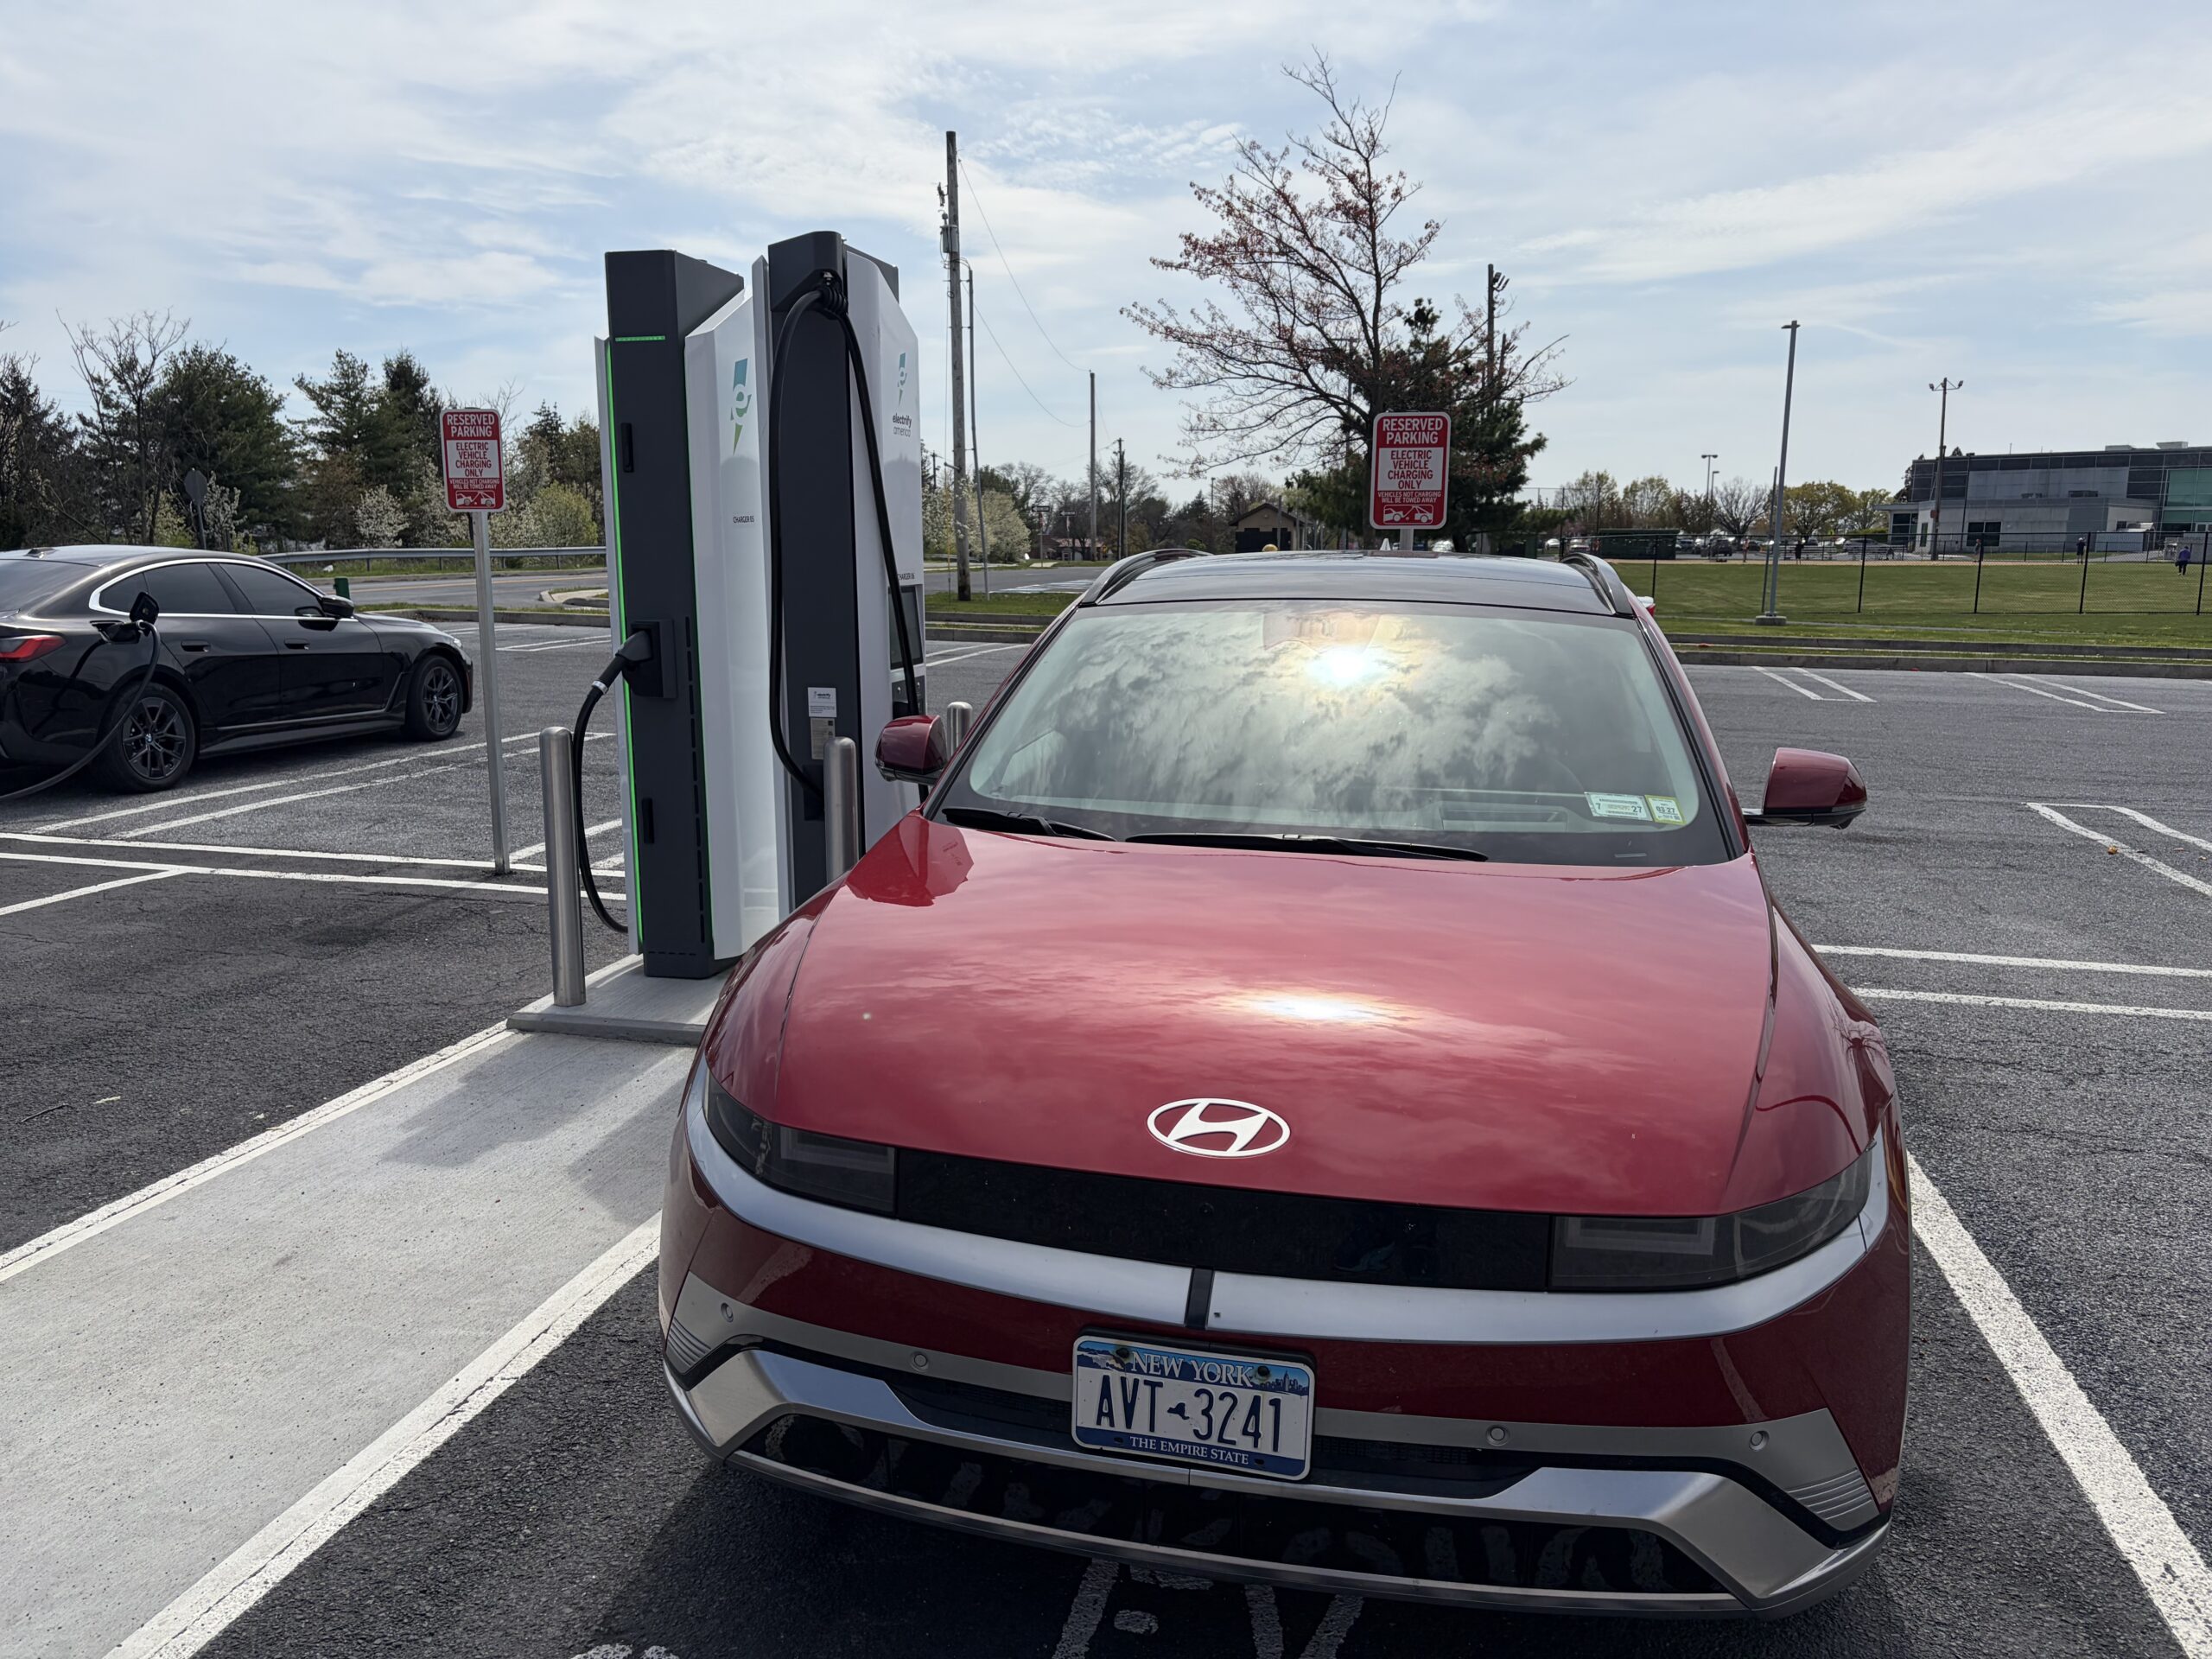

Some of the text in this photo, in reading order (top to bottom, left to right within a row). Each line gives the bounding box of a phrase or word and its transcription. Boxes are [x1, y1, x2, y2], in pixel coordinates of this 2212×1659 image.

[447, 414, 495, 426] RESERVED
[893, 412, 912, 428] electrify
[1382, 418, 1443, 431] RESERVED
[450, 426, 492, 437] PARKING
[893, 426, 911, 437] america
[1386, 432, 1438, 444] PARKING
[455, 442, 489, 450] ELECTRIC
[1390, 449, 1432, 460] ELECTRIC
[455, 460, 492, 468] CHARGING
[1393, 460, 1429, 469] VEHICLE
[1388, 470, 1433, 480] CHARGING
[1398, 480, 1422, 489] ONLY
[1131, 1351, 1253, 1387] NEW YORK
[1096, 1374, 1281, 1452] AVT 3241
[1129, 1436, 1249, 1465] THE EMPIRE STATE
